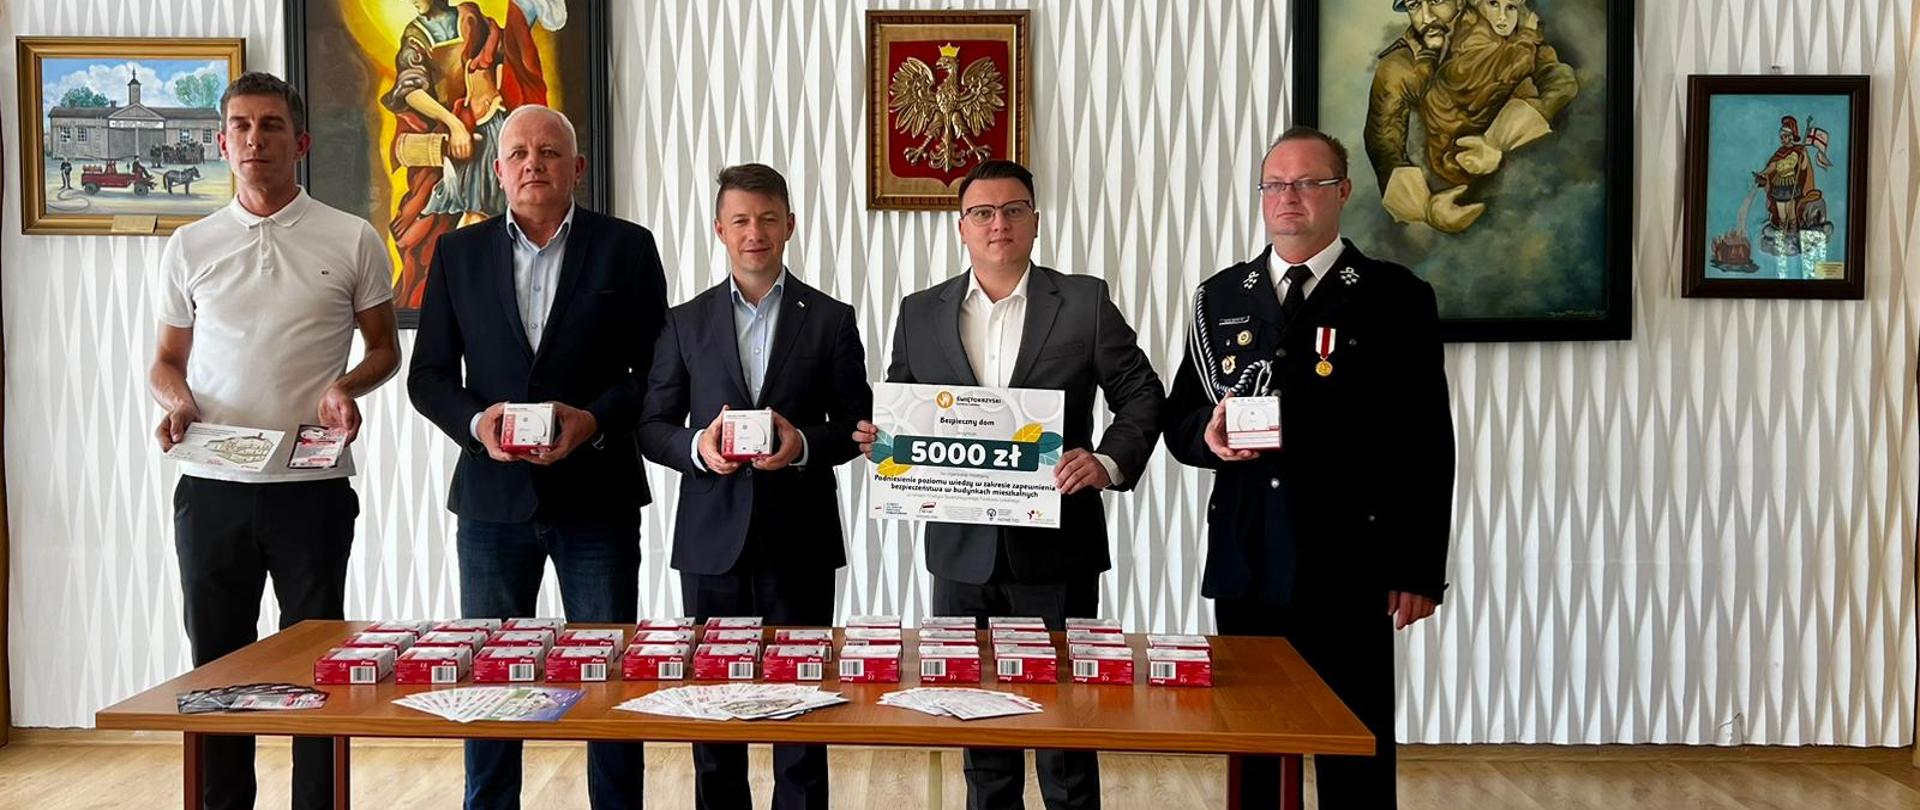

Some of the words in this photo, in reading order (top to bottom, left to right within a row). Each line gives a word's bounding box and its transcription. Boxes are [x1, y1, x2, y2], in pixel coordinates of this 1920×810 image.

[940, 417, 977, 427] Bezpieczny
[979, 418, 995, 426] dom
[911, 441, 986, 466] 5000
[993, 444, 1022, 468] zł
[874, 474, 916, 483] Podniesienie
[949, 478, 973, 488] wiedzy
[1012, 483, 1056, 491] zapewnienia
[891, 483, 943, 492] bezpieczeństwa
[953, 486, 991, 496] budynkach
[992, 489, 1039, 499] mieszkalnych
